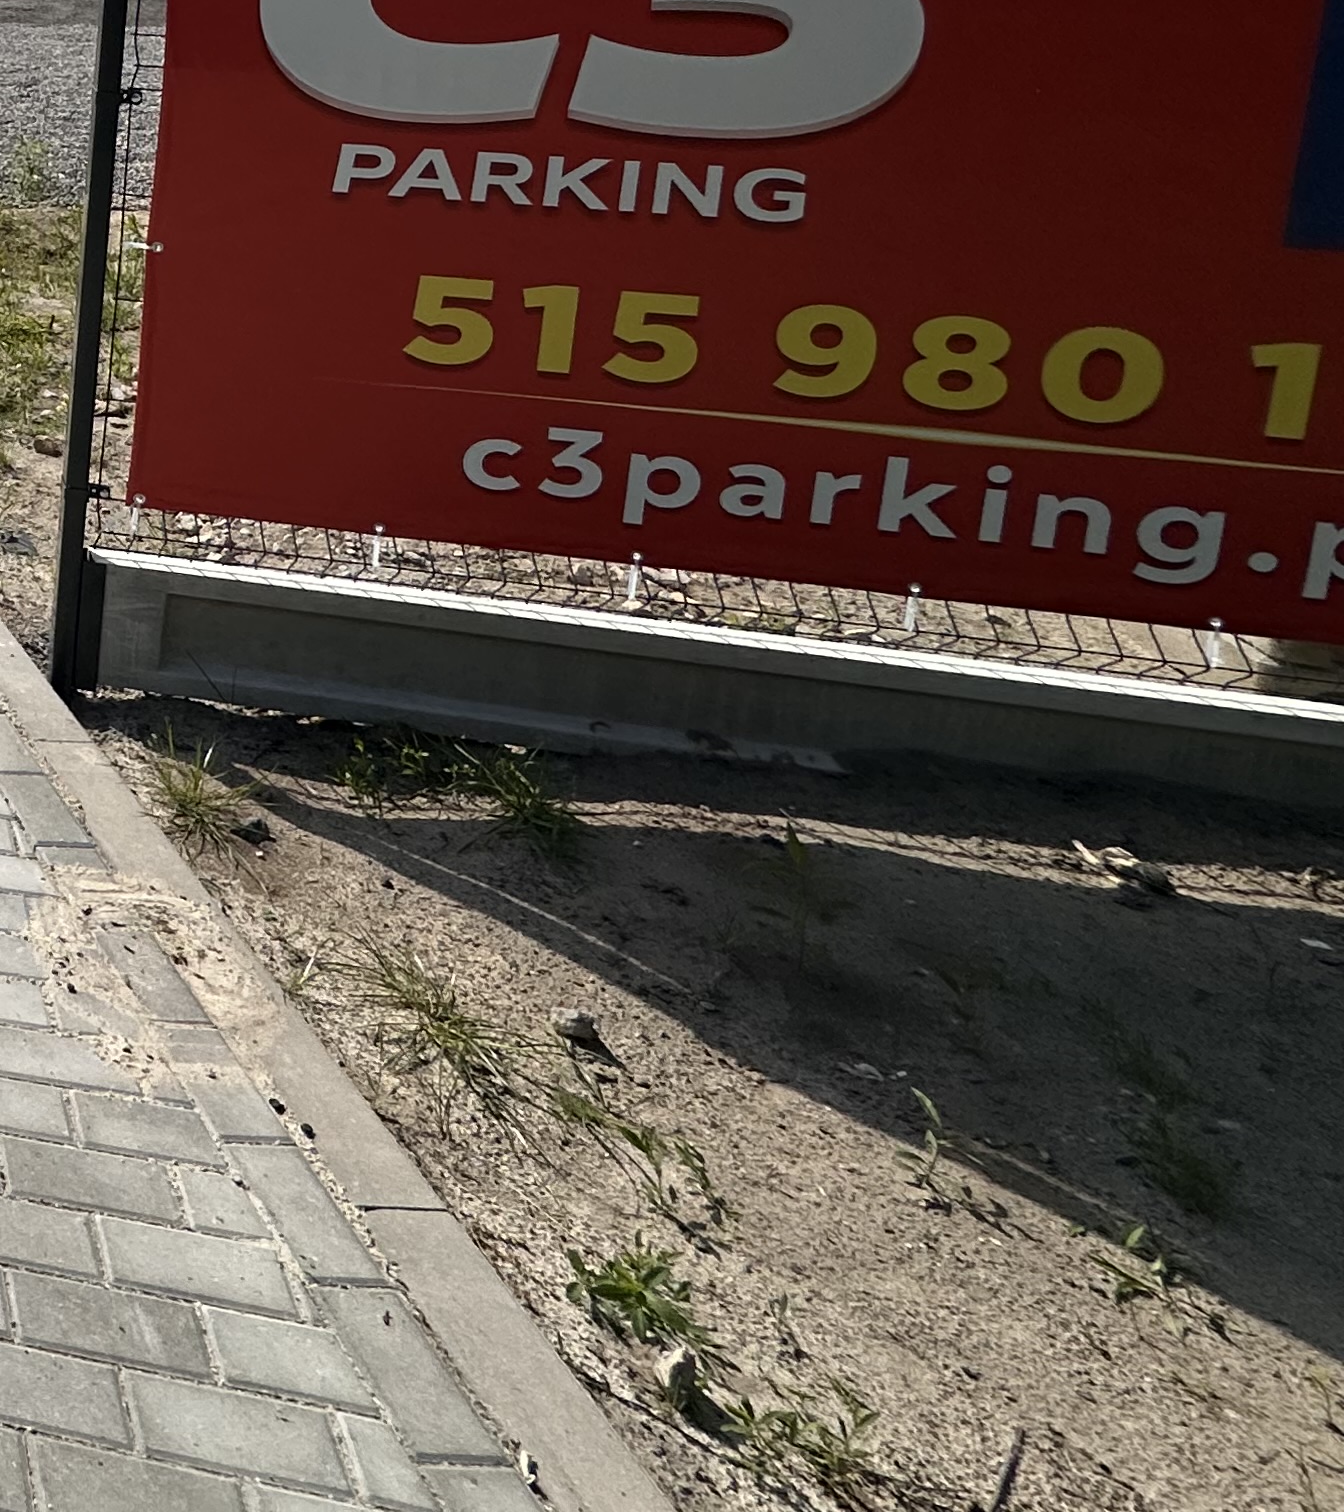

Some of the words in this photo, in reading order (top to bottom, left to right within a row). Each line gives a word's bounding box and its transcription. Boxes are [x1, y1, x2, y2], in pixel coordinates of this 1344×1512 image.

[331, 143, 808, 223] PARKING
[403, 274, 700, 383] 515
[773, 304, 1165, 424] 980
